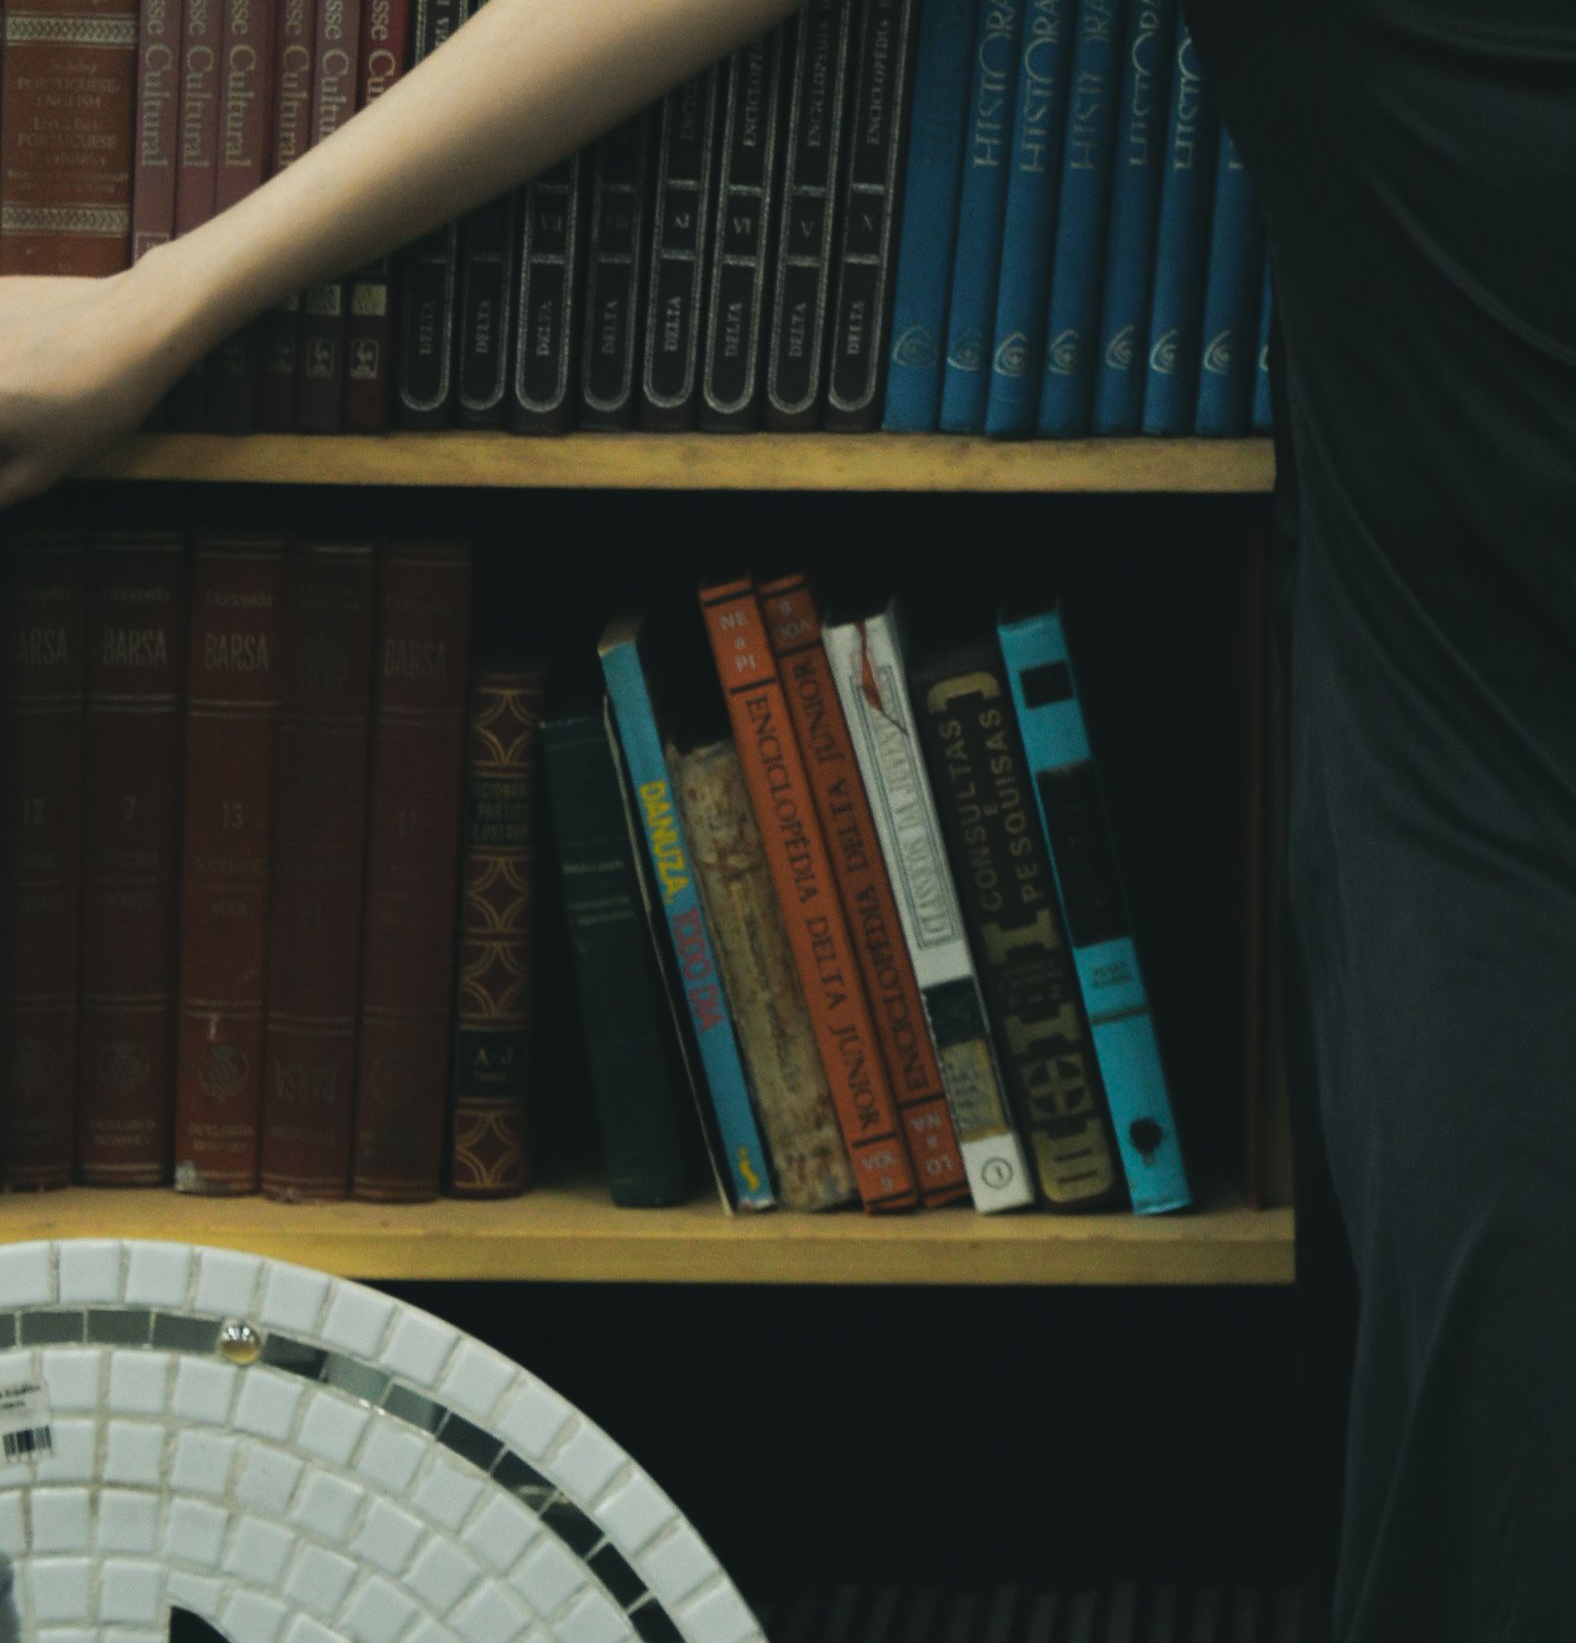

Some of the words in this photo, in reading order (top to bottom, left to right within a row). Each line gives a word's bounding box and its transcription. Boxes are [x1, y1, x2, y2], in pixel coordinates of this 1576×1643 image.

[140, 43, 173, 169] Cultural
[180, 43, 212, 168] Cultural
[223, 45, 258, 168] Cultural
[724, 302, 743, 357] DELTA
[846, 300, 865, 355] DELTA
[719, 613, 747, 631] NE
[101, 632, 167, 668] BARSA
[204, 633, 269, 672] BARSA
[735, 655, 758, 673] PI
[221, 802, 243, 830] 13
[939, 718, 1005, 914] CONSULTAS
[977, 707, 1044, 905] PESQUISAS
[985, 801, 998, 817] E
[746, 695, 818, 906] ENCICLOPÉDIA
[804, 917, 848, 1010] DELTA
[672, 907, 716, 988] TODO
